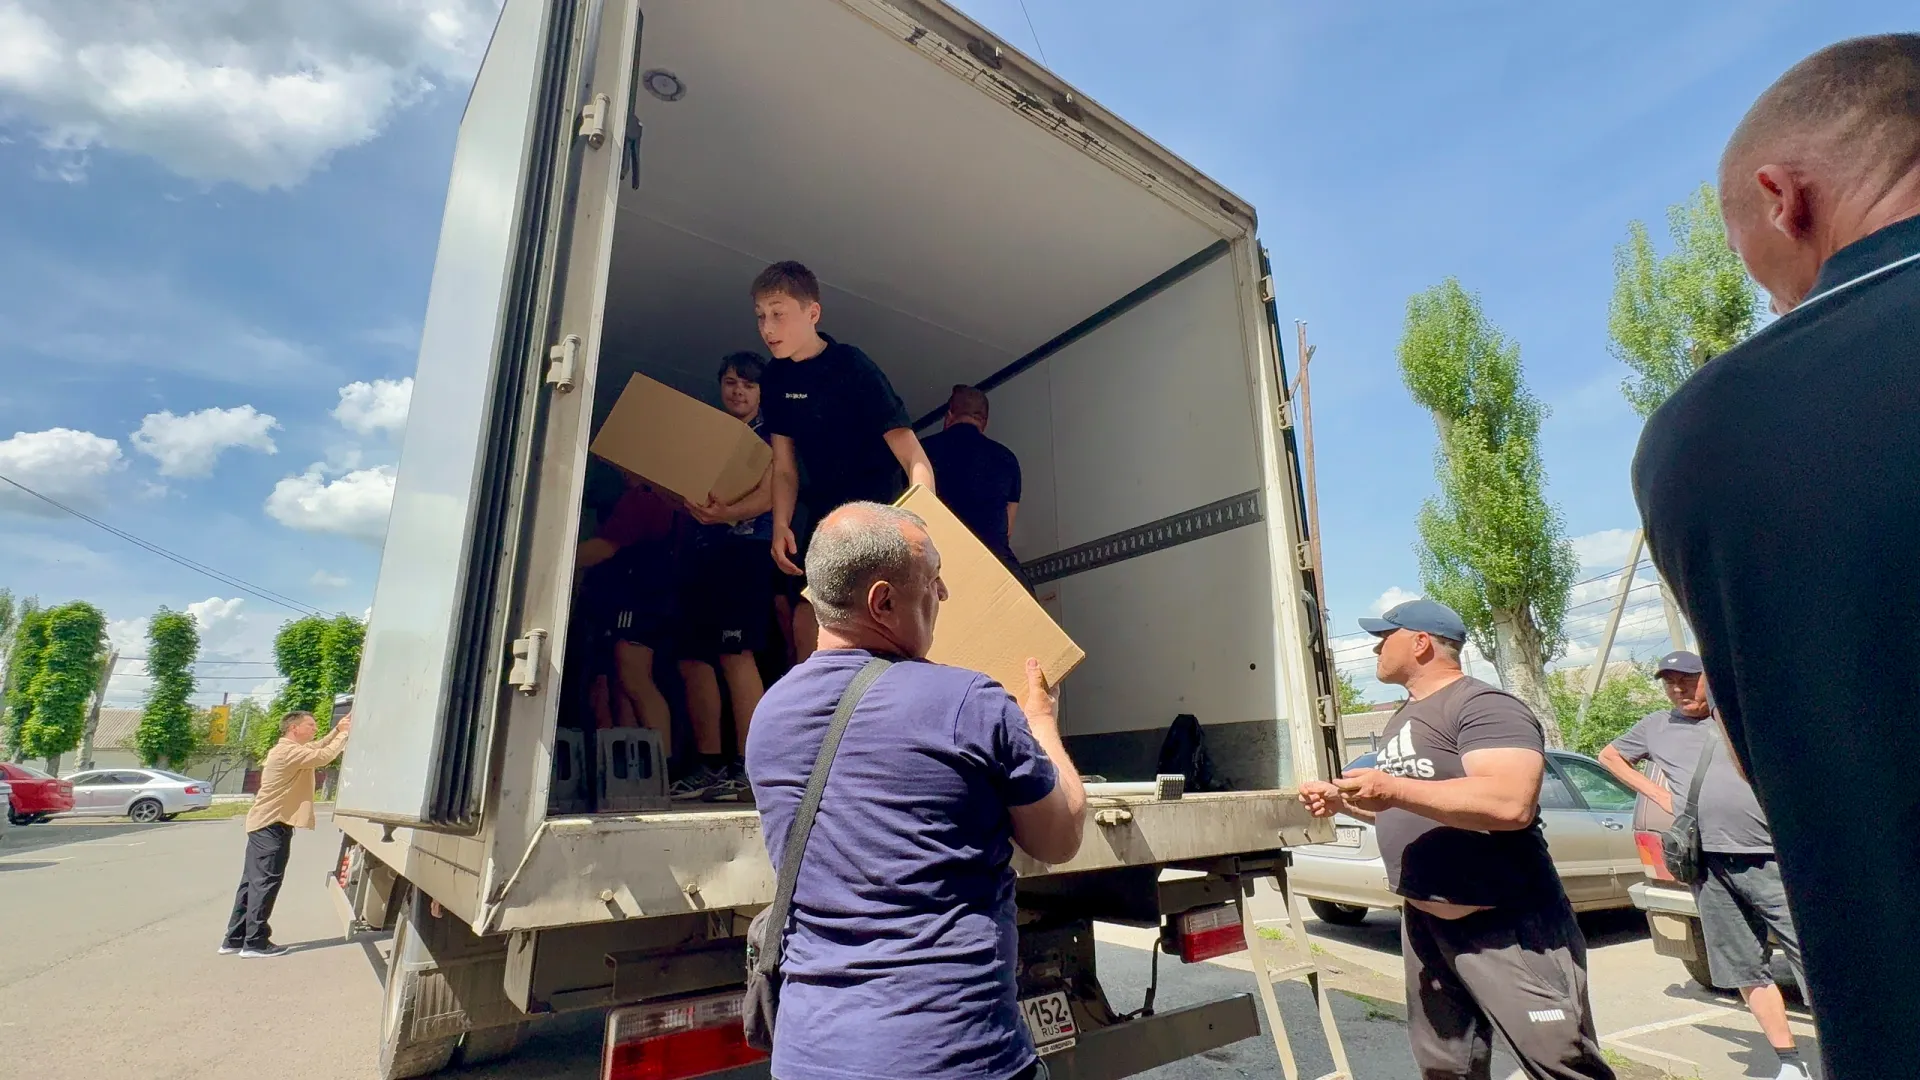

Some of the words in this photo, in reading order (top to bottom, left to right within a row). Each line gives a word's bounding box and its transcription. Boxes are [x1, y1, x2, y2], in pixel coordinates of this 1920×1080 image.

[1029, 997, 1066, 1027] 152
[1528, 1009, 1566, 1022] PUMA
[1041, 1024, 1060, 1037] RUS
